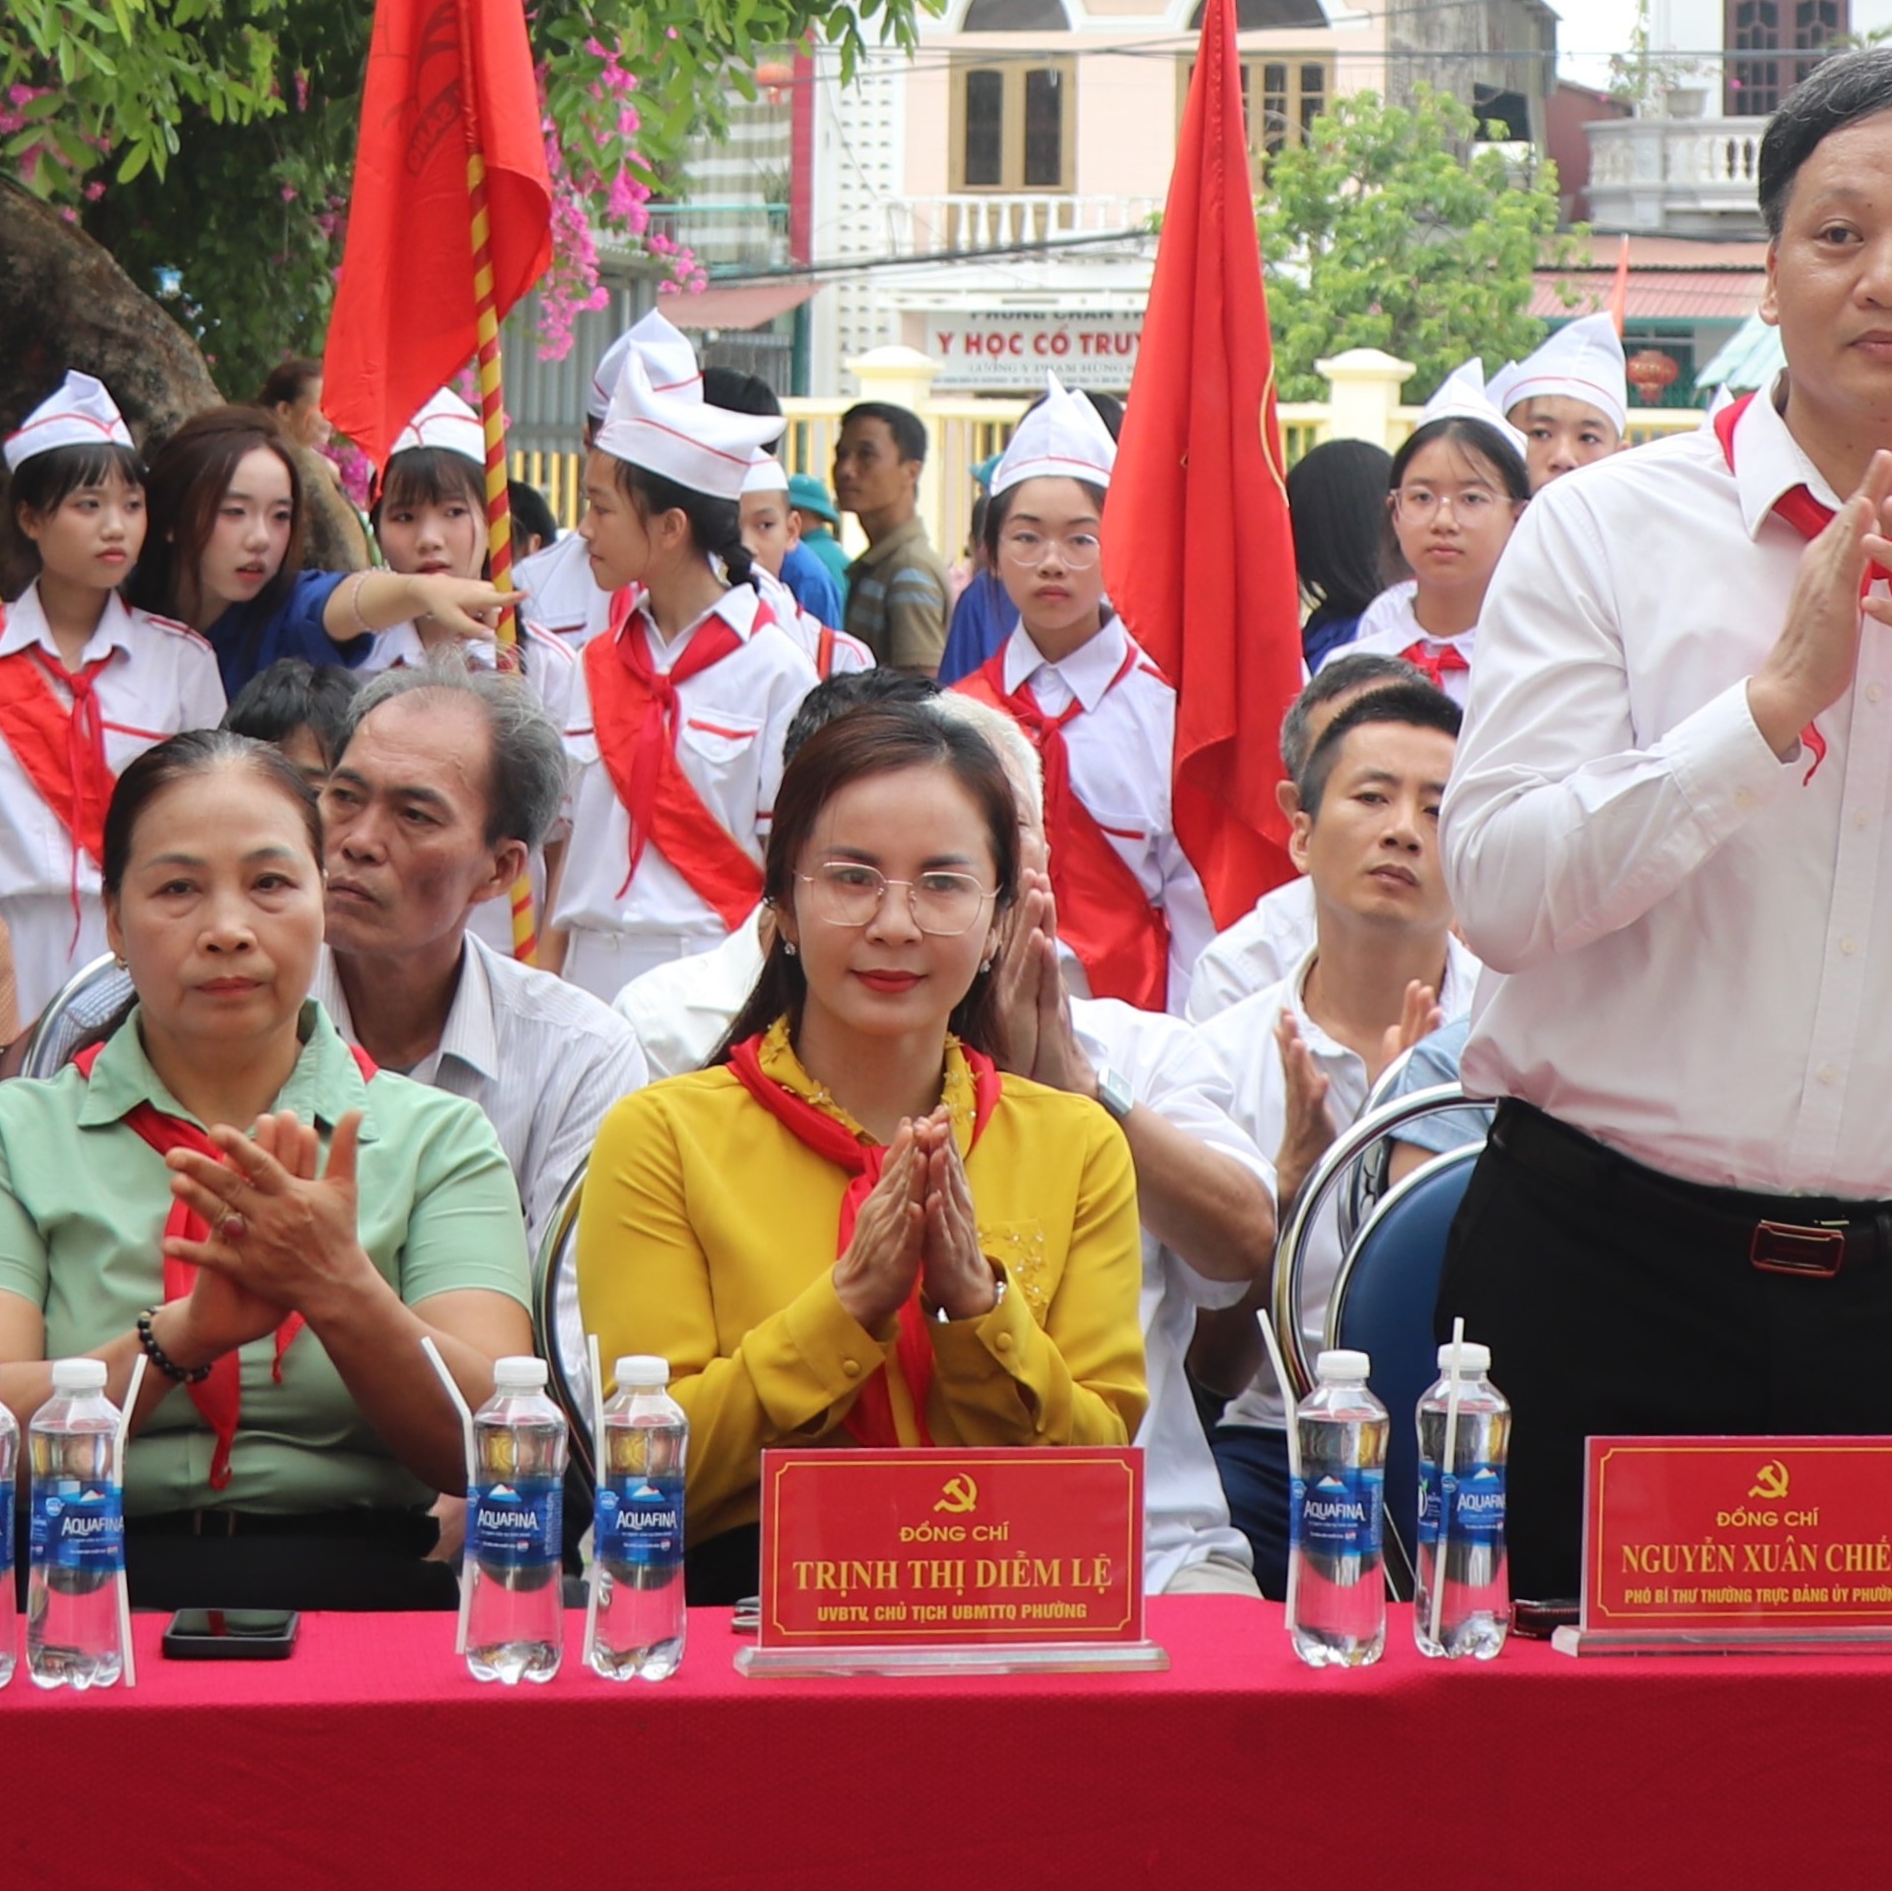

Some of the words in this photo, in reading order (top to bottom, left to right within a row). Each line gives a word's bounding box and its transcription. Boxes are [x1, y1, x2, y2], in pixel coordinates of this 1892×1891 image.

[937, 331, 954, 355] Y
[965, 331, 1023, 362] HỌC
[1033, 323, 1071, 355] CỔ
[477, 1508, 540, 1531] AQUAFINA
[616, 1510, 678, 1531] AQUAFINA
[1303, 1499, 1366, 1522] AQUAFINA
[1716, 1505, 1779, 1527] ĐỒNG
[1783, 1507, 1820, 1527] CHÍ
[61, 1516, 125, 1537] AQUAFINA
[899, 1520, 967, 1543] ĐỒNG
[971, 1520, 1010, 1542] CHÍ
[1621, 1536, 1736, 1574] NGUYỄN
[1743, 1536, 1820, 1573] XUÂN
[793, 1559, 898, 1597] TRỊNH
[907, 1559, 966, 1596] THỊ
[975, 1550, 1062, 1589] DIỄM
[1070, 1553, 1113, 1594] LỆ
[1625, 1586, 1651, 1604] PHÓ
[1655, 1585, 1669, 1604] BÍ
[1672, 1587, 1698, 1604] THƯ
[1700, 1586, 1753, 1604] THƯỜNG
[1756, 1587, 1789, 1606] TRỰC
[1793, 1583, 1829, 1603] ĐẢNG
[874, 1600, 907, 1621] CHỦ
[911, 1605, 948, 1624] TỊCH
[952, 1603, 1017, 1622] UBMTTQ
[1021, 1601, 1087, 1620] PHƯỜNG
